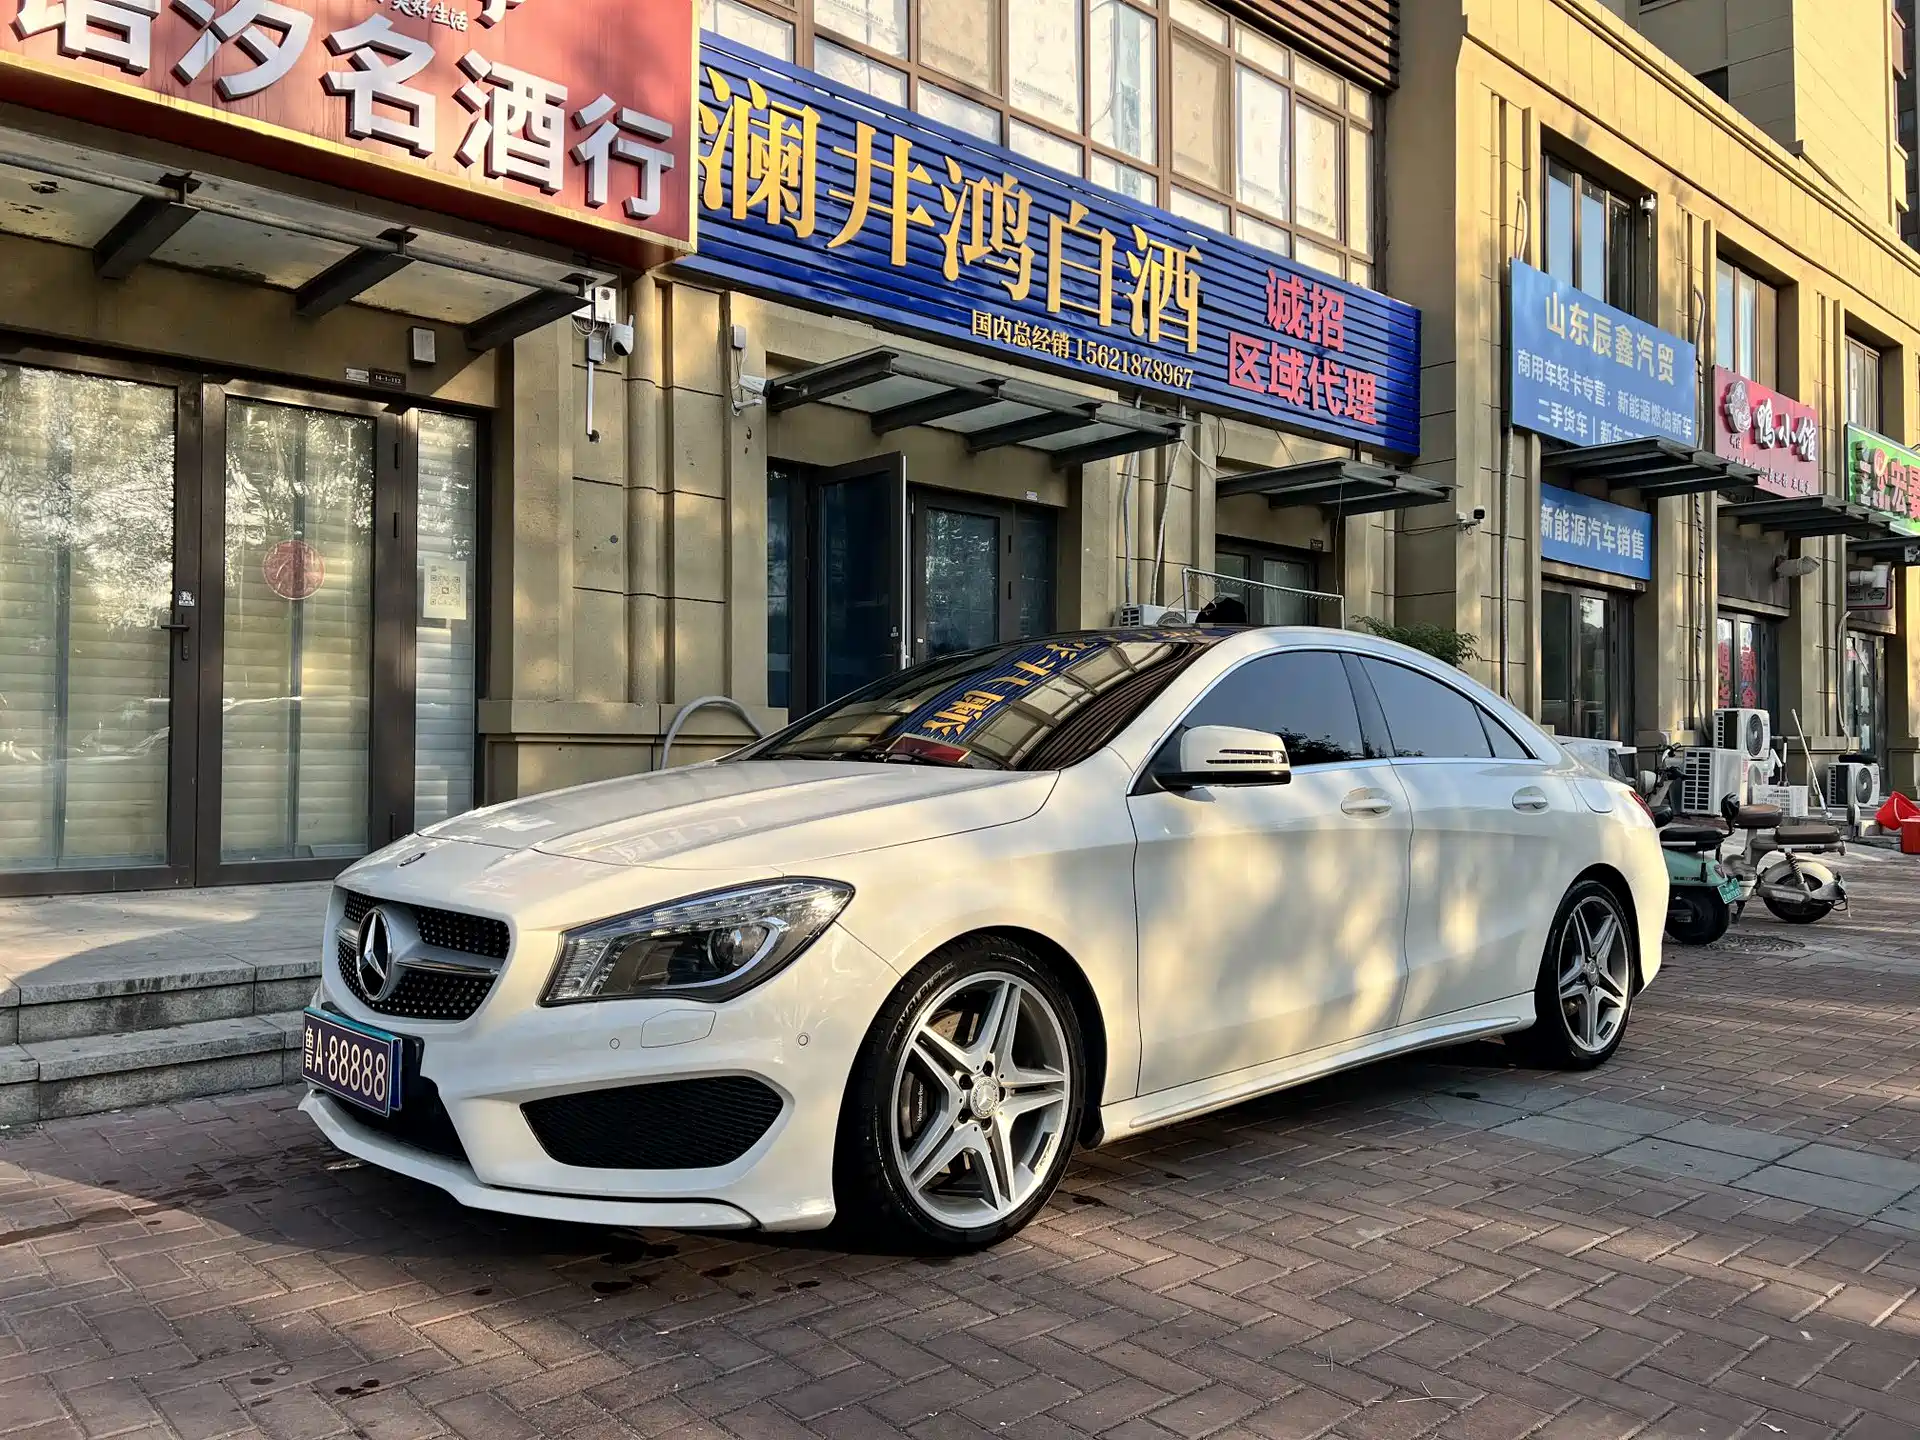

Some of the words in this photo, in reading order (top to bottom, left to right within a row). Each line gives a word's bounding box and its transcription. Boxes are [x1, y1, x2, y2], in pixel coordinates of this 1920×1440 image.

[697, 65, 1204, 354] 澜井鸿白酒
[971, 308, 1070, 359] 国内总经销
[1075, 337, 1195, 391] 15621878967
[1265, 267, 1346, 353] 诚招
[1545, 291, 1675, 386] 山东辰鑫汽贸
[1228, 330, 1378, 425] 区域代理
[1536, 397, 1589, 439] 二手货车
[1754, 397, 1817, 462] 鸭小馆
[1541, 503, 1646, 561] 新能源汽车销售
